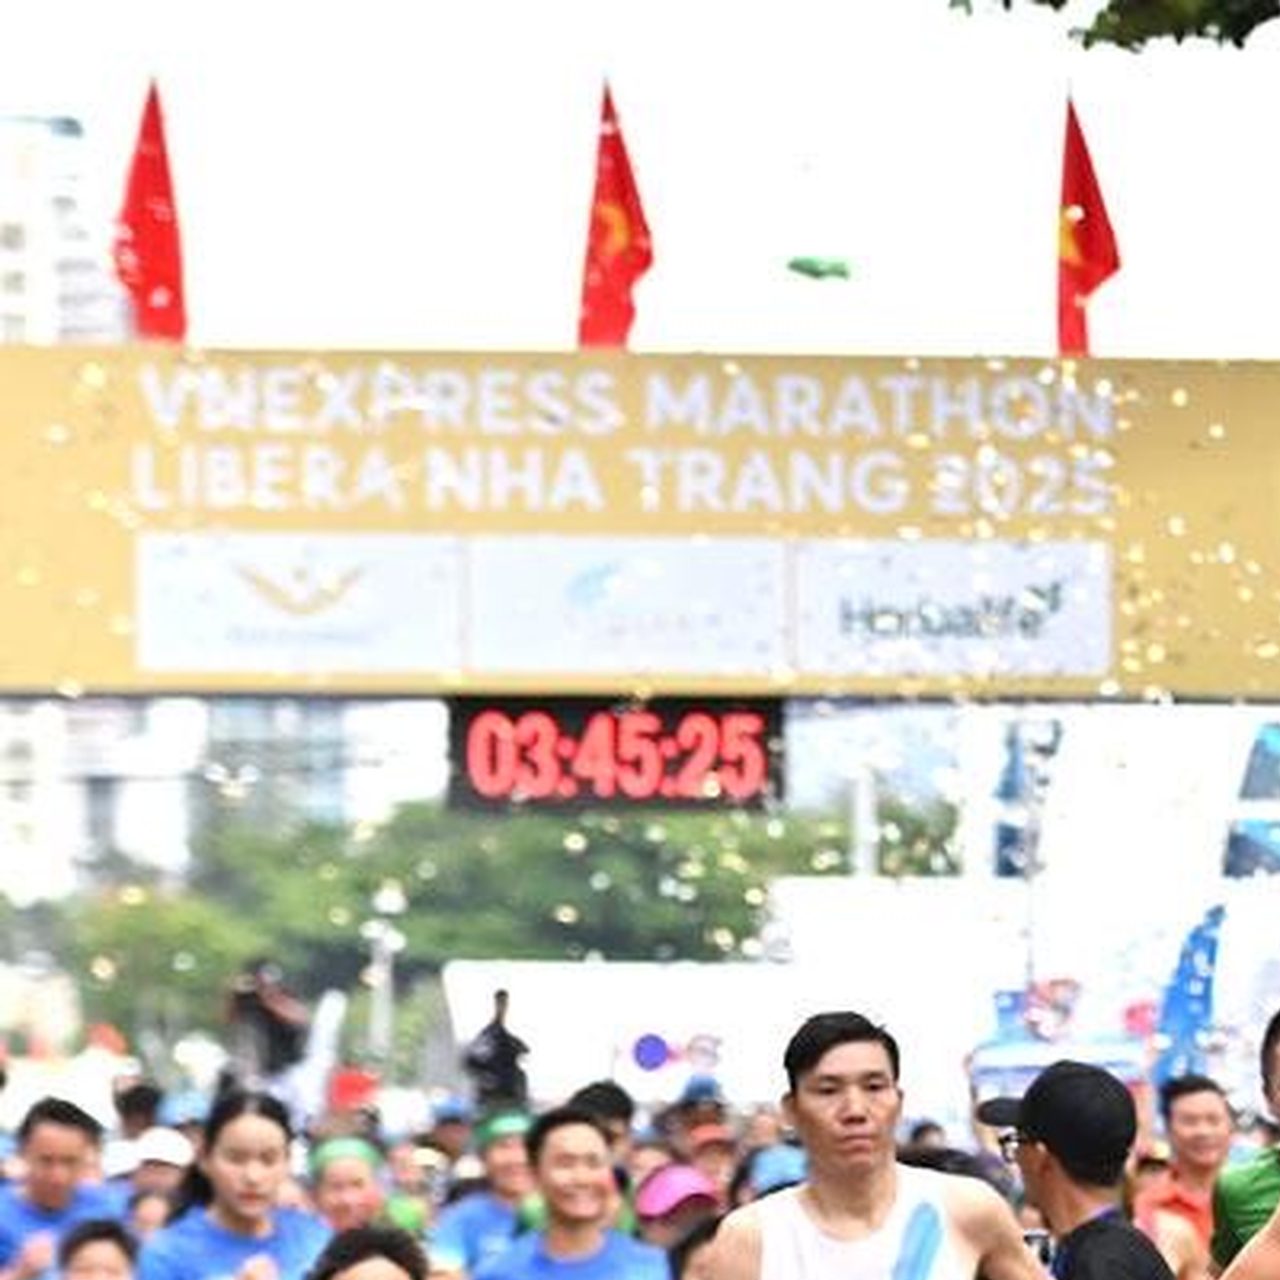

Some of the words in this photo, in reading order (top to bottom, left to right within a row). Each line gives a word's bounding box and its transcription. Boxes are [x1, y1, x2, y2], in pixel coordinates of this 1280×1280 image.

[141, 366, 622, 434] VNEXPRESS
[646, 371, 1115, 439] MARATHON
[131, 445, 409, 513] LIBERA
[426, 447, 606, 513] NHA
[628, 449, 910, 515] TRANG
[931, 450, 1113, 516] 2025
[467, 710, 767, 797] 03:45:25
